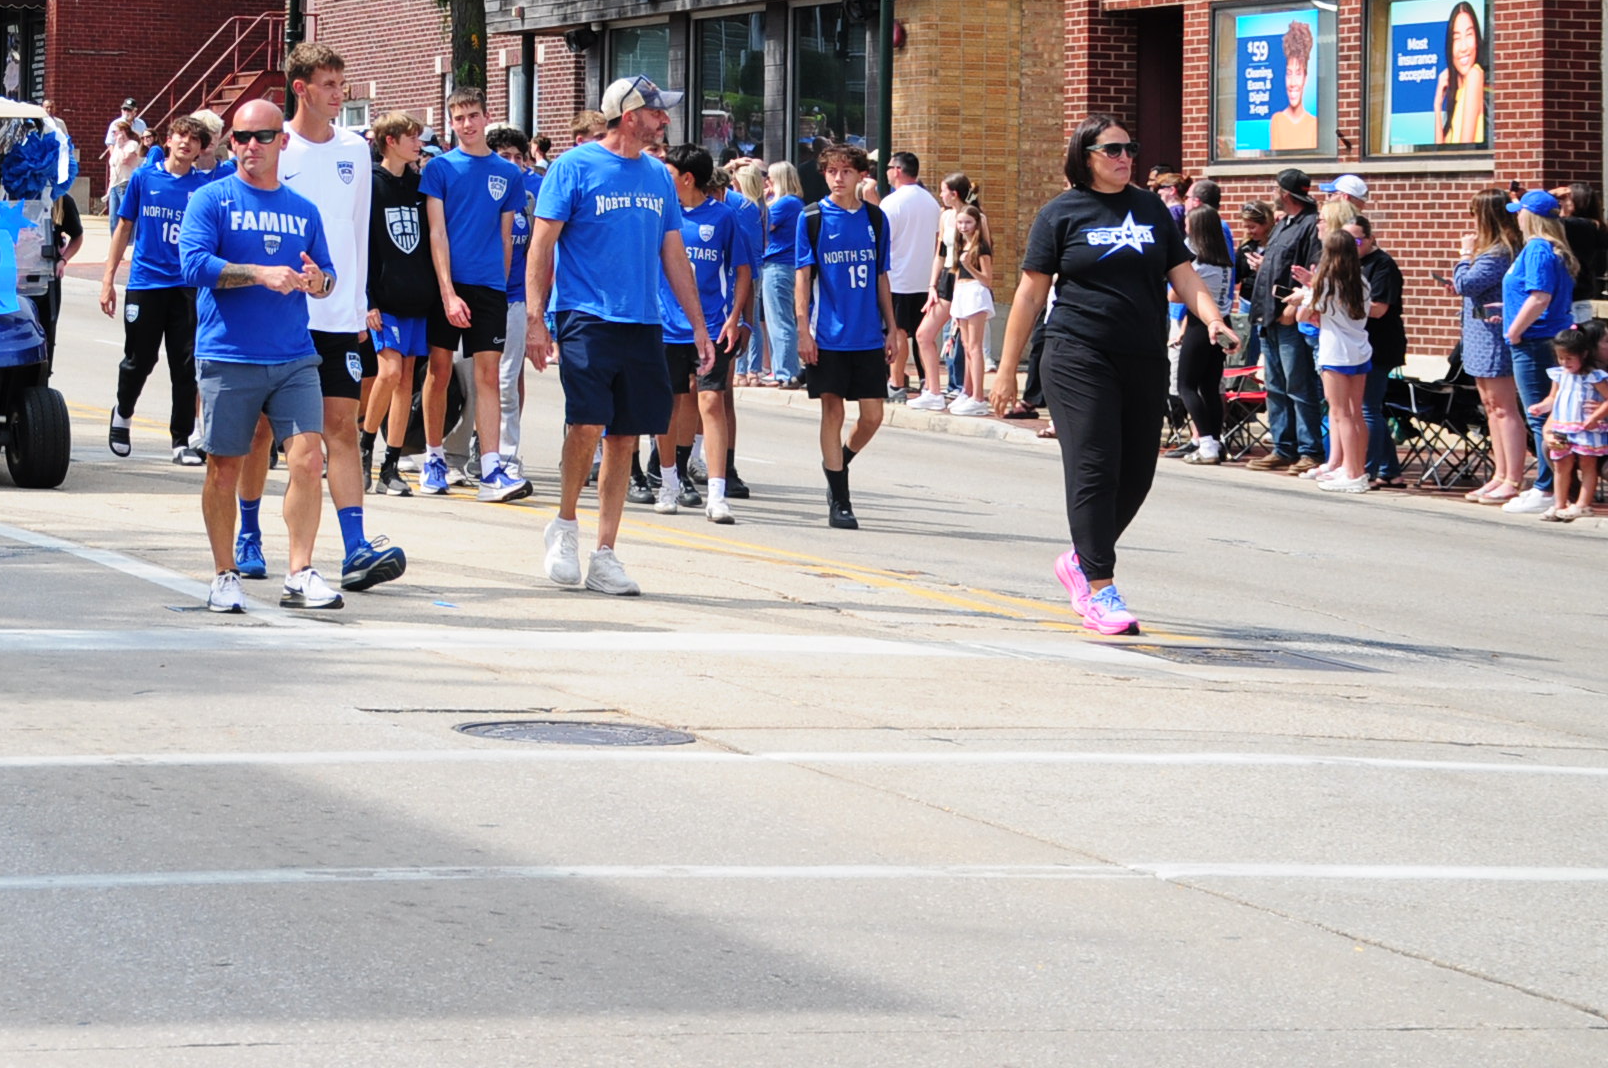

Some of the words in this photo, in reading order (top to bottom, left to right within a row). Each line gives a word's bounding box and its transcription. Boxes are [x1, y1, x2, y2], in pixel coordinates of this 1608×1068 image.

[1247, 41, 1269, 61] $59
[1407, 38, 1429, 50] Most
[1397, 53, 1438, 67] insurance
[1245, 67, 1273, 79] Cleaning,
[1398, 65, 1437, 83] accepted
[1248, 91, 1270, 104] Digital
[143, 205, 173, 221] NORTH
[230, 210, 308, 237] FAMILY
[162, 222, 180, 245] 16
[1086, 230, 1156, 246] SOCCER
[685, 246, 718, 261] STARS
[824, 250, 858, 265] NORTH
[860, 248, 877, 262] STA
[848, 264, 868, 289] 19
